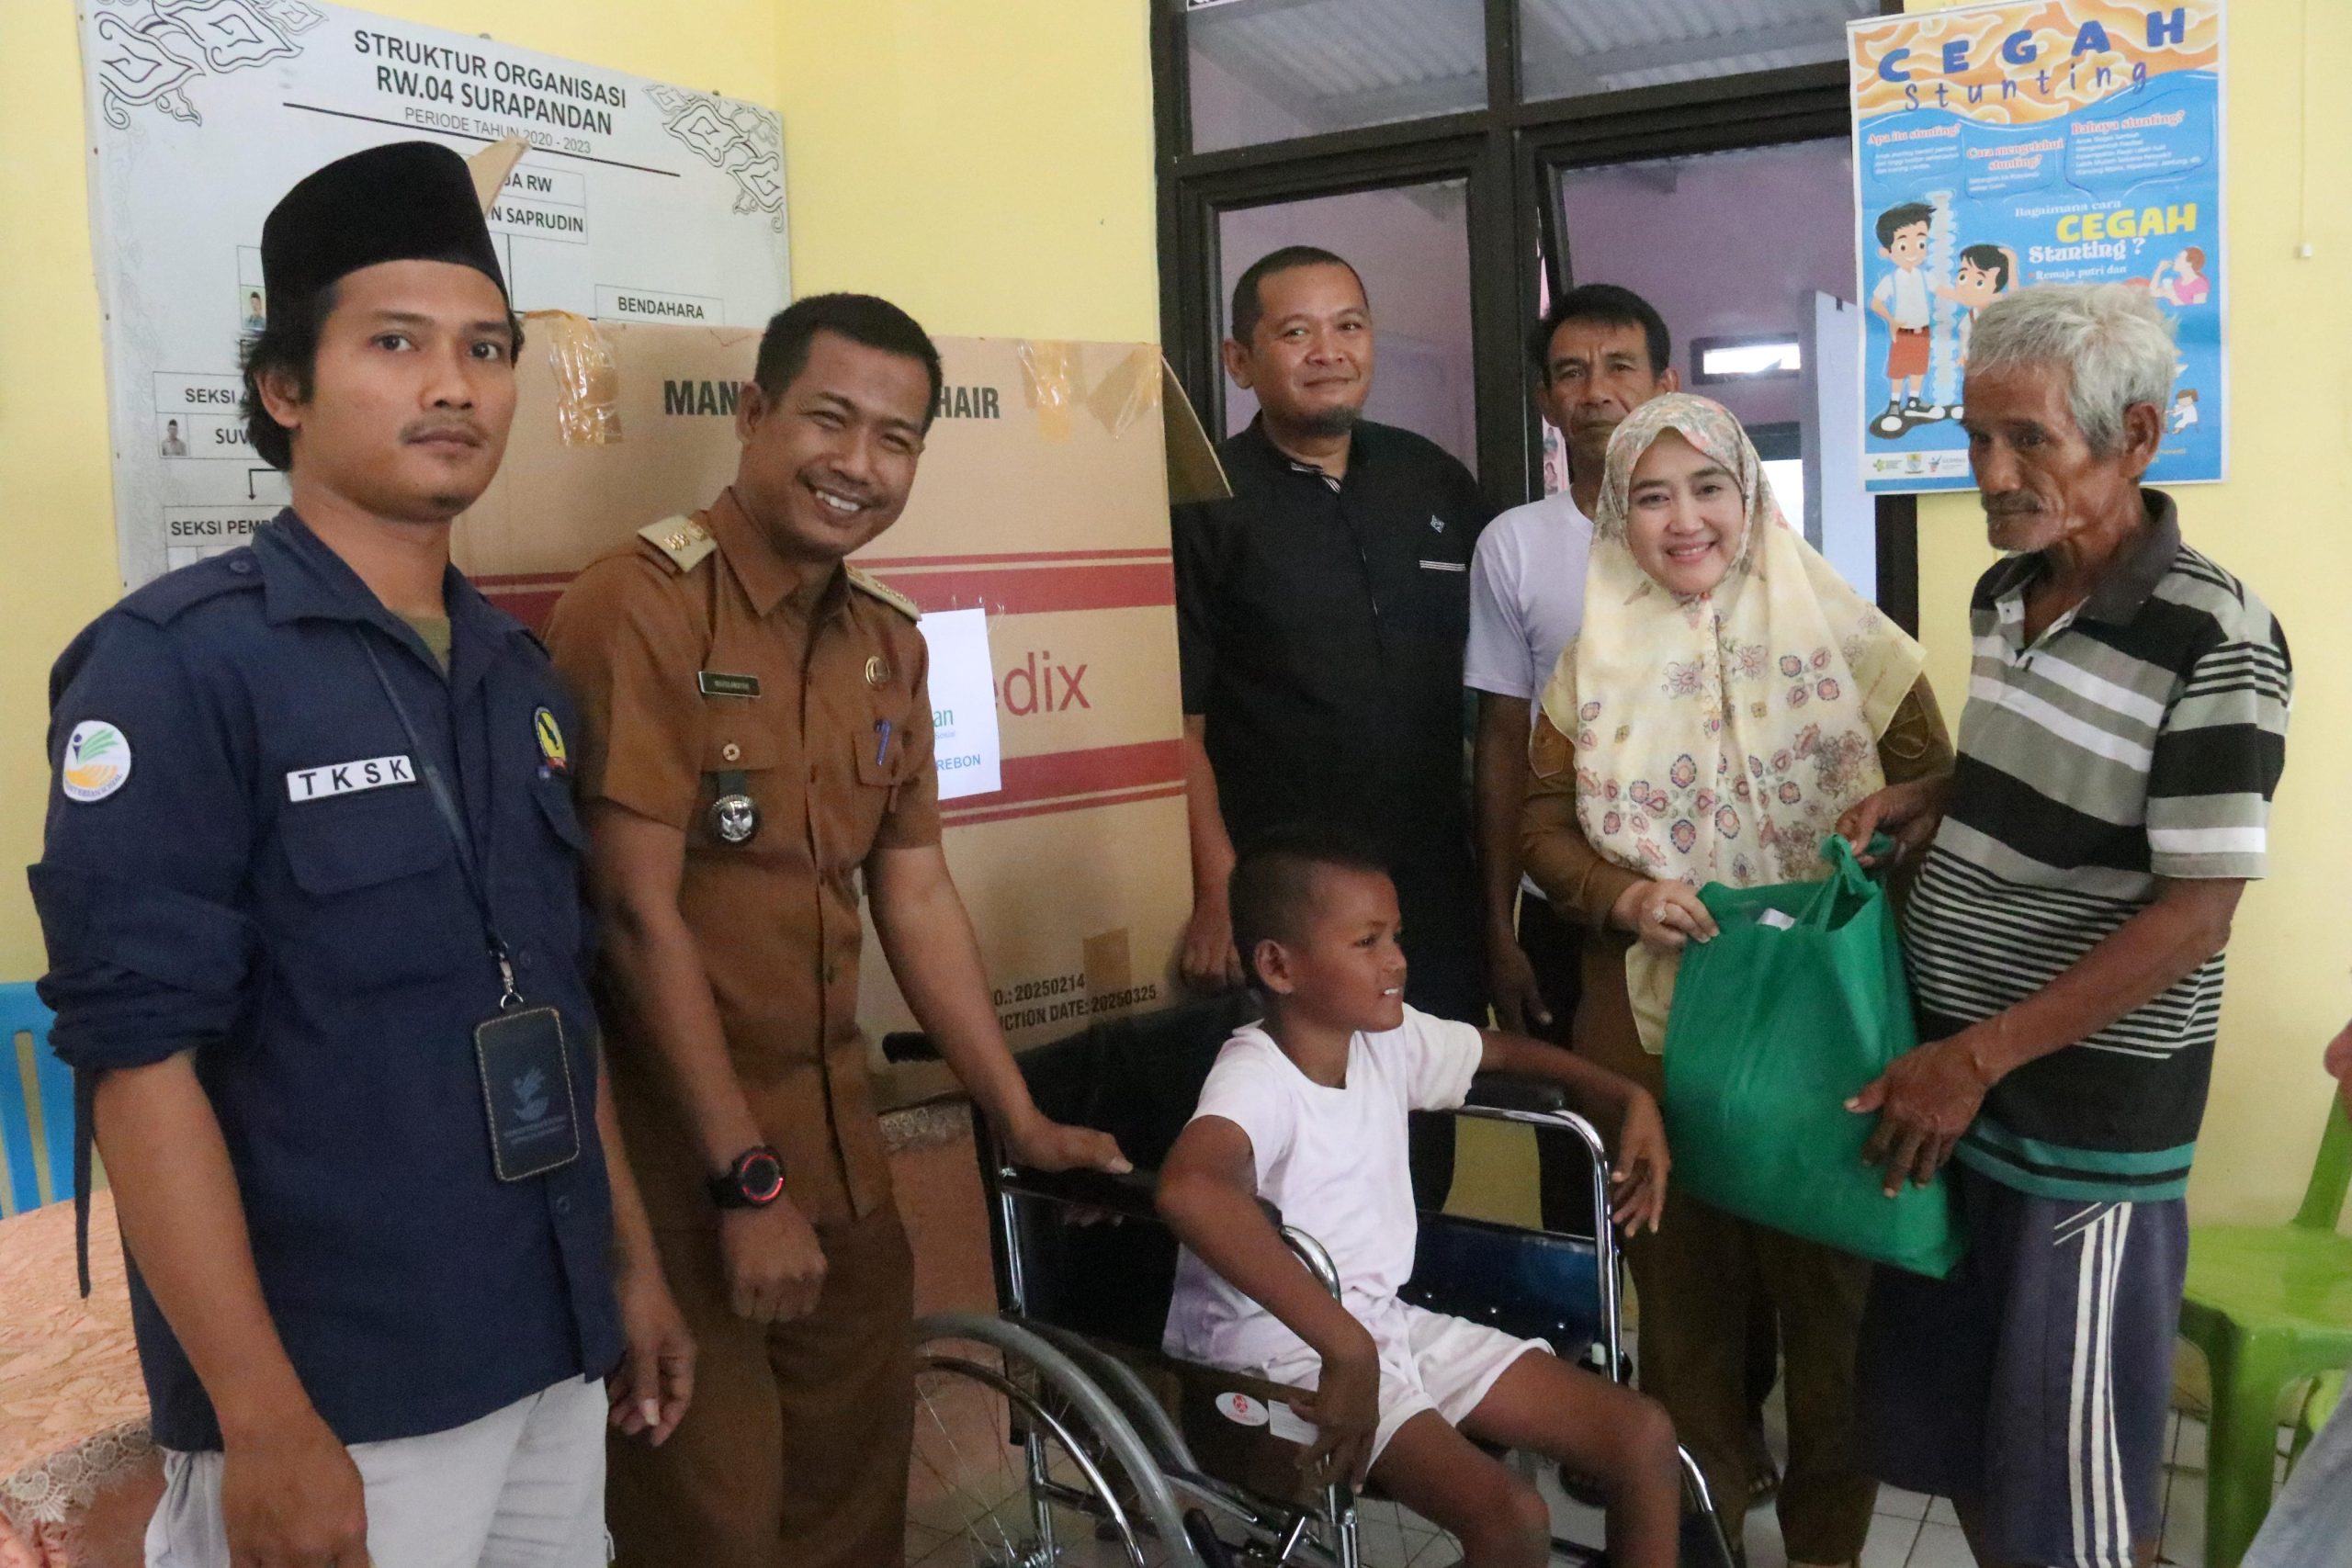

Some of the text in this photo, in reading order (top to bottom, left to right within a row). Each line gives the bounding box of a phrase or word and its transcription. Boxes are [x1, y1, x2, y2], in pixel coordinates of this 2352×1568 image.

[1878, 7, 2185, 83] CEGAH
[355, 29, 627, 108] STRUKTUR ORGANISASI
[377, 65, 612, 136] RW.04 SURAPANDAN
[1905, 62, 2146, 111] Stunting
[405, 107, 470, 132] PERIODE
[473, 119, 520, 138] TAHUN
[524, 130, 553, 147] 2020
[564, 138, 592, 154] 2023
[2072, 109, 2186, 134] Bahaya stunting?
[1995, 138, 2064, 156] mengetahui
[1988, 154, 2042, 171] stunting?
[526, 175, 553, 193] RW
[506, 208, 584, 232] SAPRUDIN
[2015, 200, 2121, 218] Bagaimana cara
[2056, 203, 2198, 243] CEGAH
[2029, 237, 2146, 264] Stunting ?
[2035, 265, 2128, 281] Remaja putri dan
[617, 296, 706, 320] BENDAHARA
[185, 389, 236, 404] SEKSI
[663, 380, 744, 415] MAN
[933, 386, 1001, 419] HAIR
[171, 519, 271, 536] SEKSI PEM
[993, 650, 1091, 716] dix
[299, 759, 409, 795] TKSK
[936, 754, 981, 772] REBON
[1014, 974, 1085, 1003] 20250214
[1091, 985, 1157, 1014] 20250325
